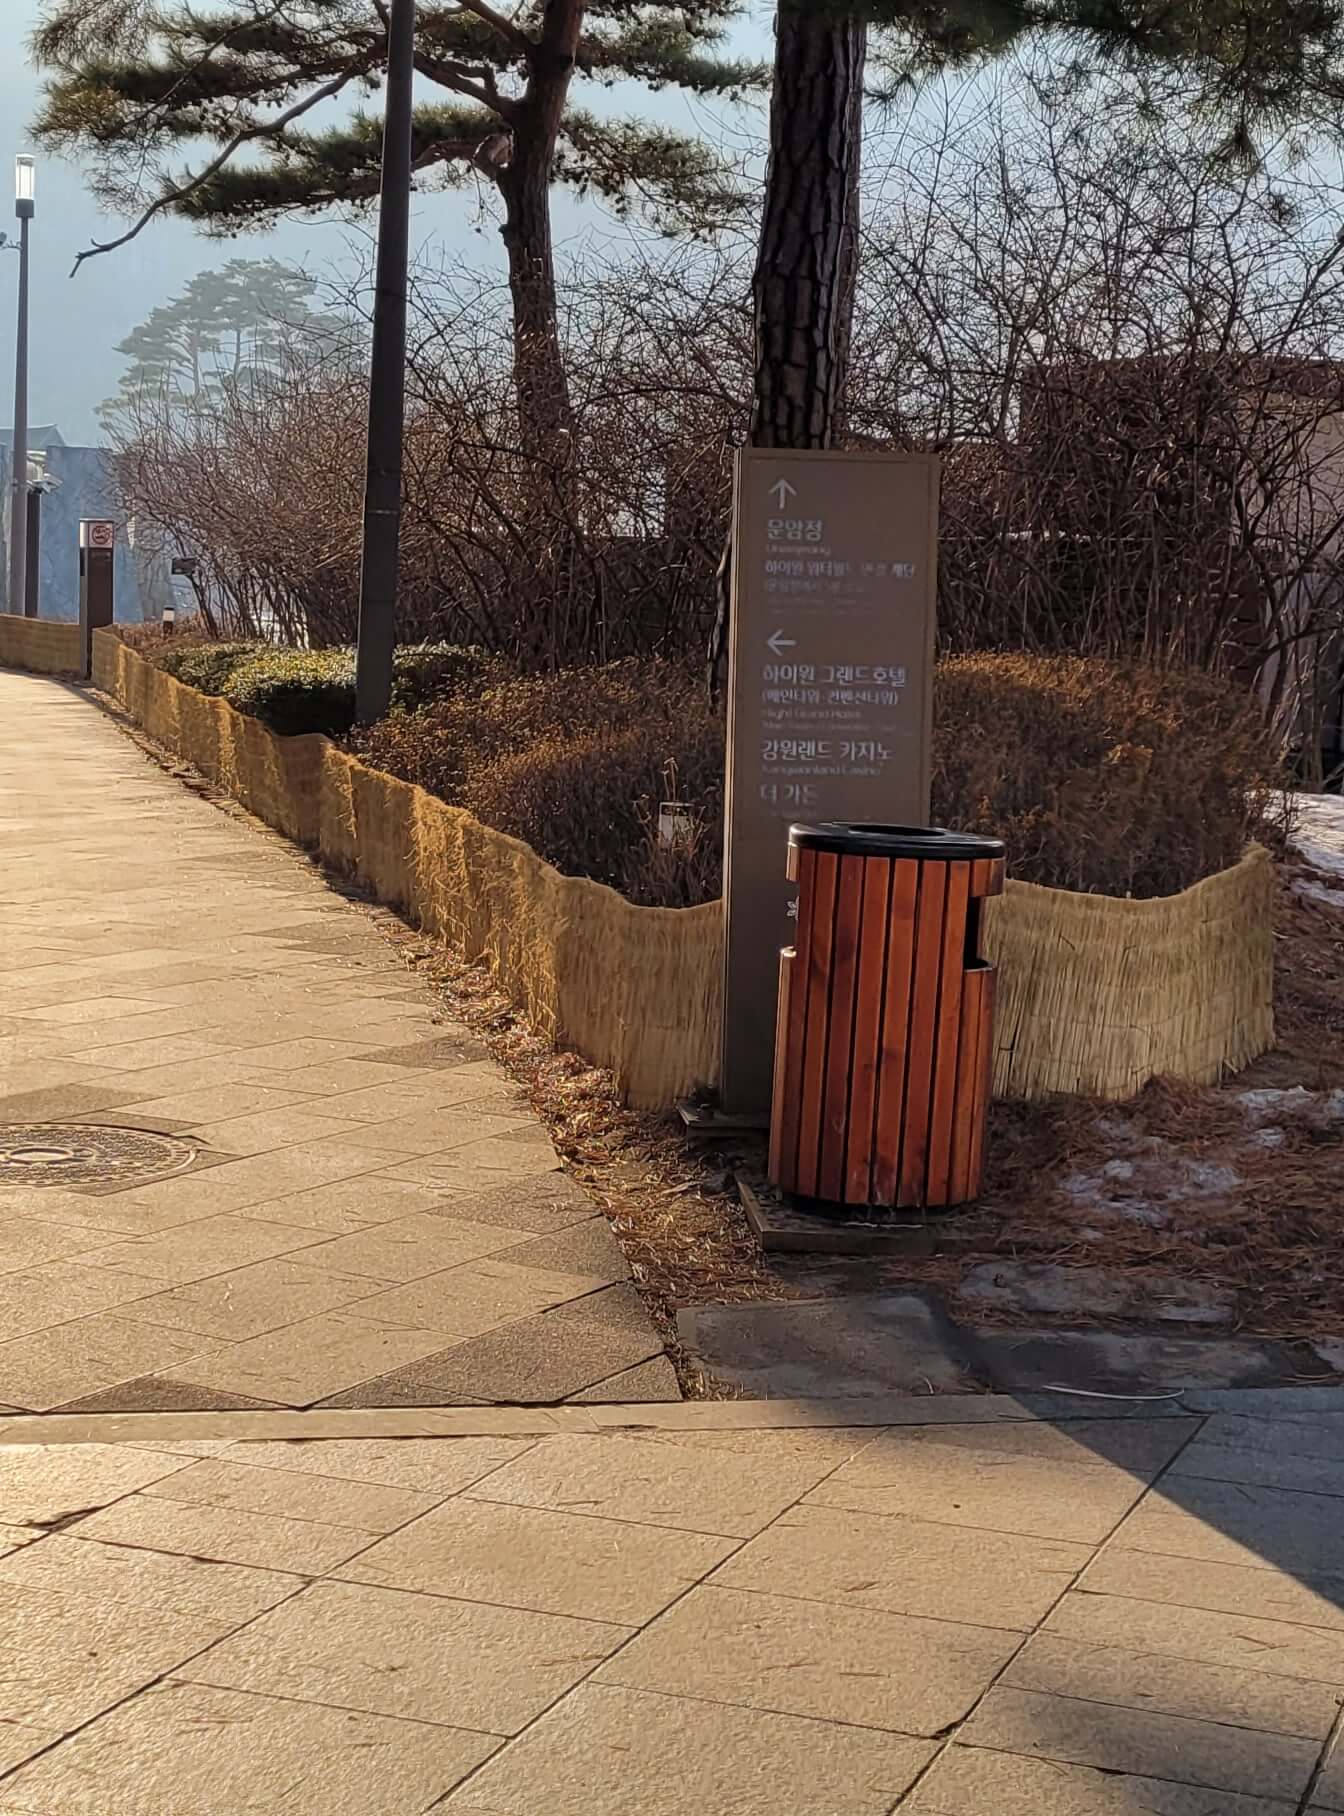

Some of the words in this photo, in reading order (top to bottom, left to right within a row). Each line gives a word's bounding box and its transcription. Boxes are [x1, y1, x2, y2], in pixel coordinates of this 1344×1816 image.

[767, 519, 823, 540] 운암정
[763, 664, 815, 685] 하이원
[762, 739, 833, 761] 강원랜드
[839, 741, 894, 761] 카지노
[760, 783, 777, 804] 더
